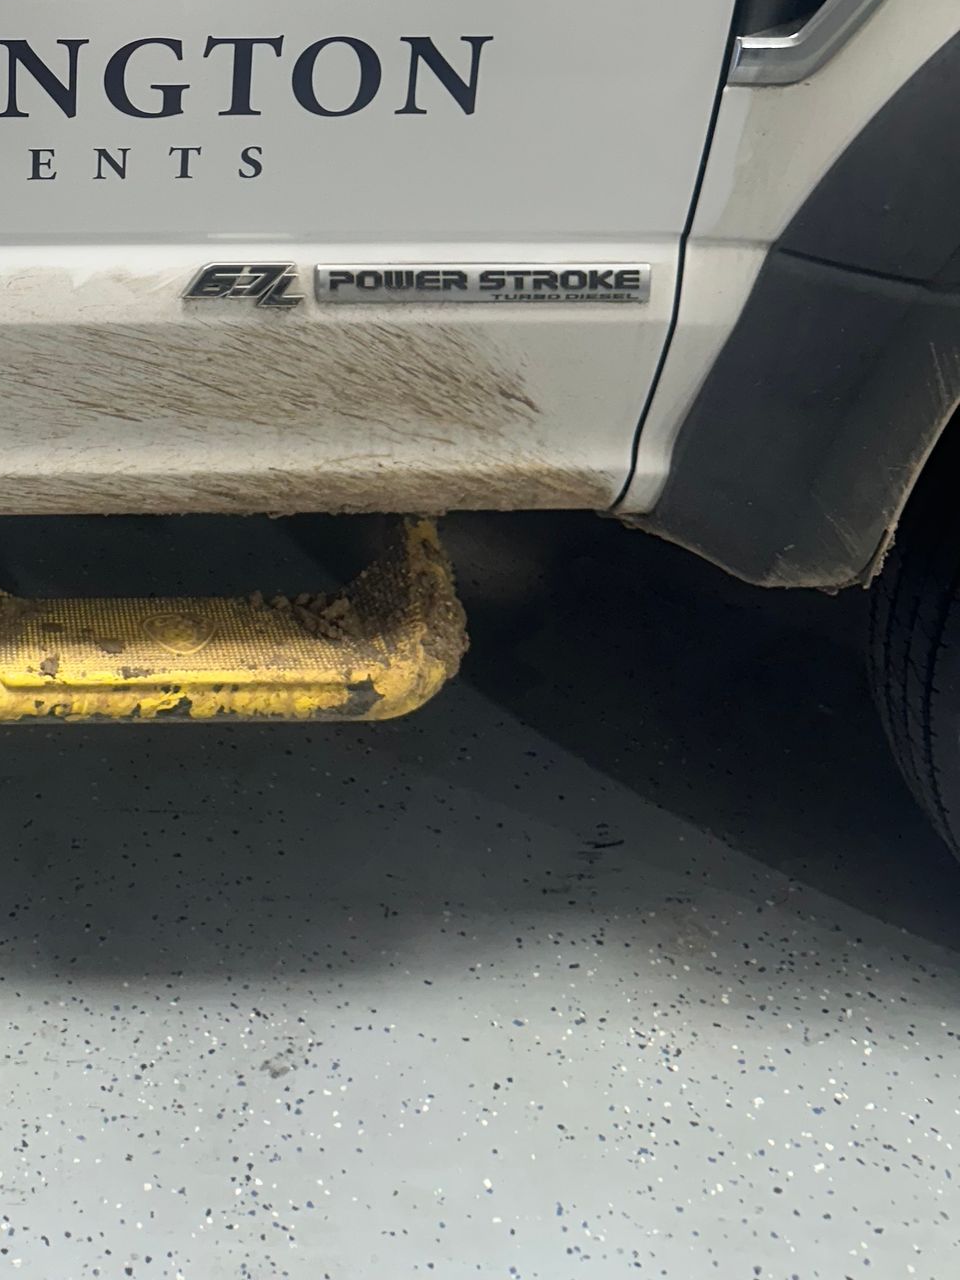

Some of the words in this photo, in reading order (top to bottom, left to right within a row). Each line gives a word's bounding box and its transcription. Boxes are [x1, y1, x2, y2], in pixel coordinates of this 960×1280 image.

[329, 269, 469, 292] POWER
[478, 269, 641, 291] STROKE
[492, 293, 561, 301] TURBO
[565, 293, 639, 301] DIESEL
